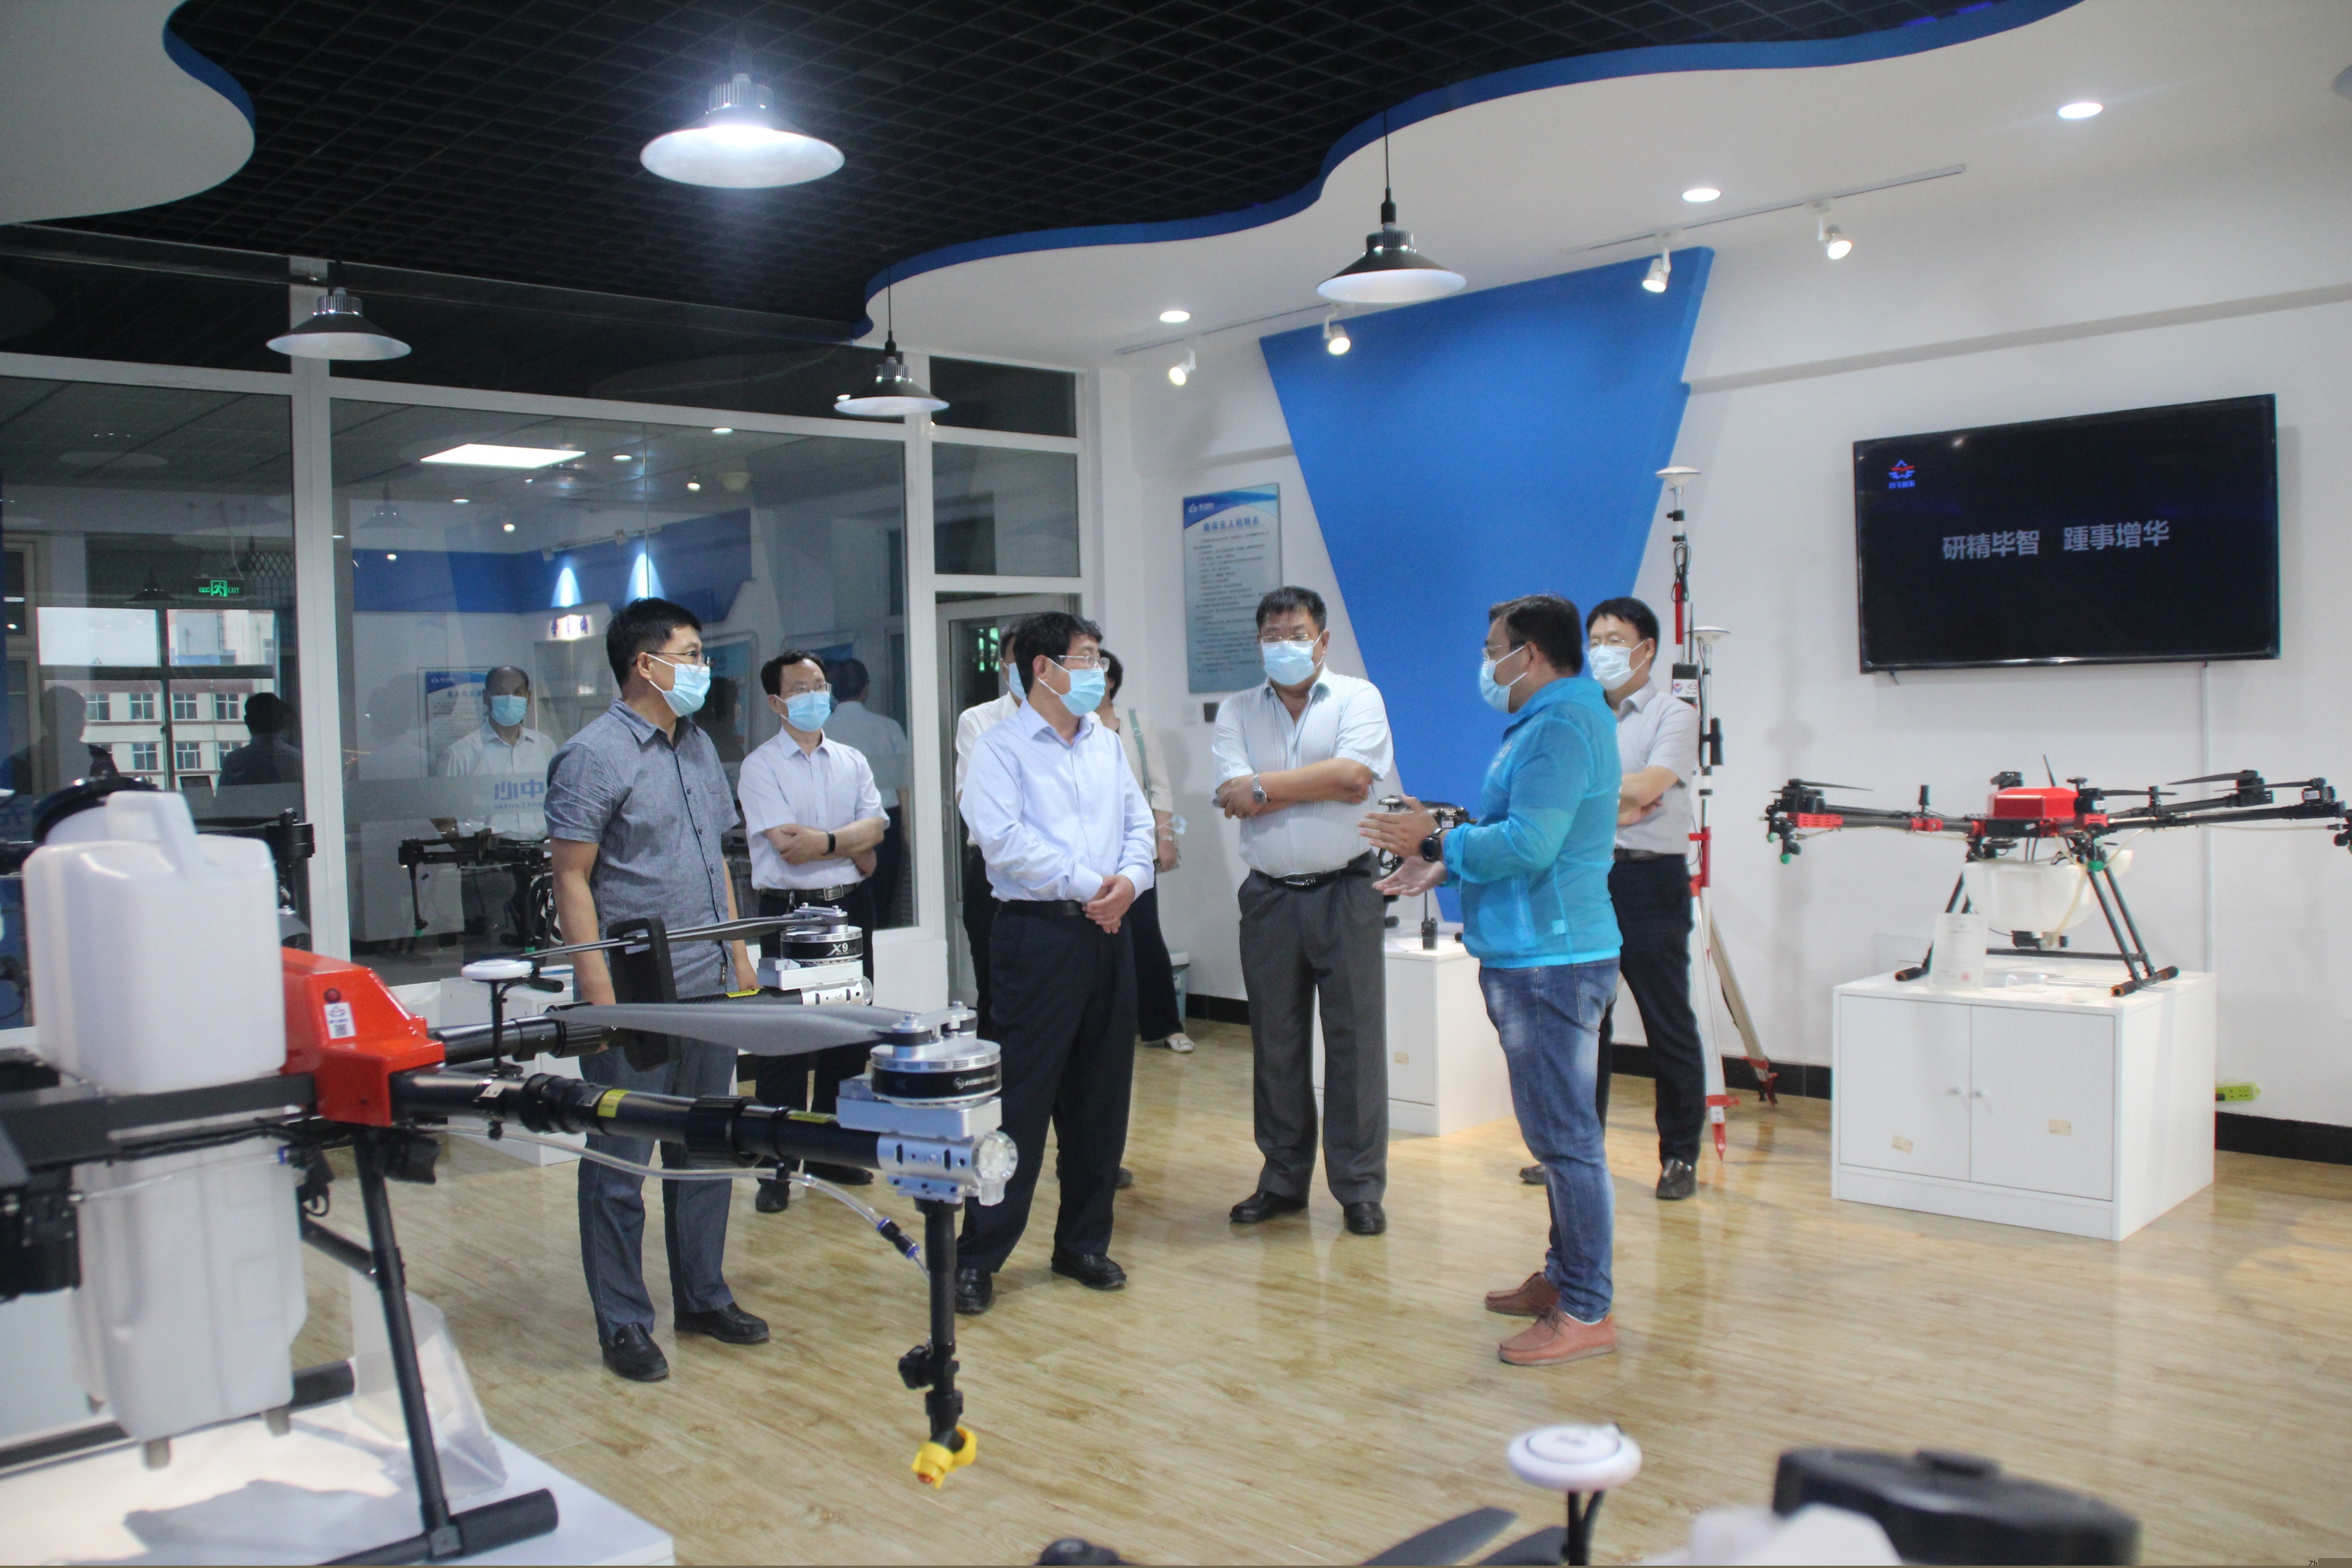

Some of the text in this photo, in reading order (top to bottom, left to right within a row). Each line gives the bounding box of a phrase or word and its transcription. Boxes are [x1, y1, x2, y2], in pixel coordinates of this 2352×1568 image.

[1943, 520, 2169, 559] 研精毕智 踵事增华
[826, 942, 849, 956] X9
